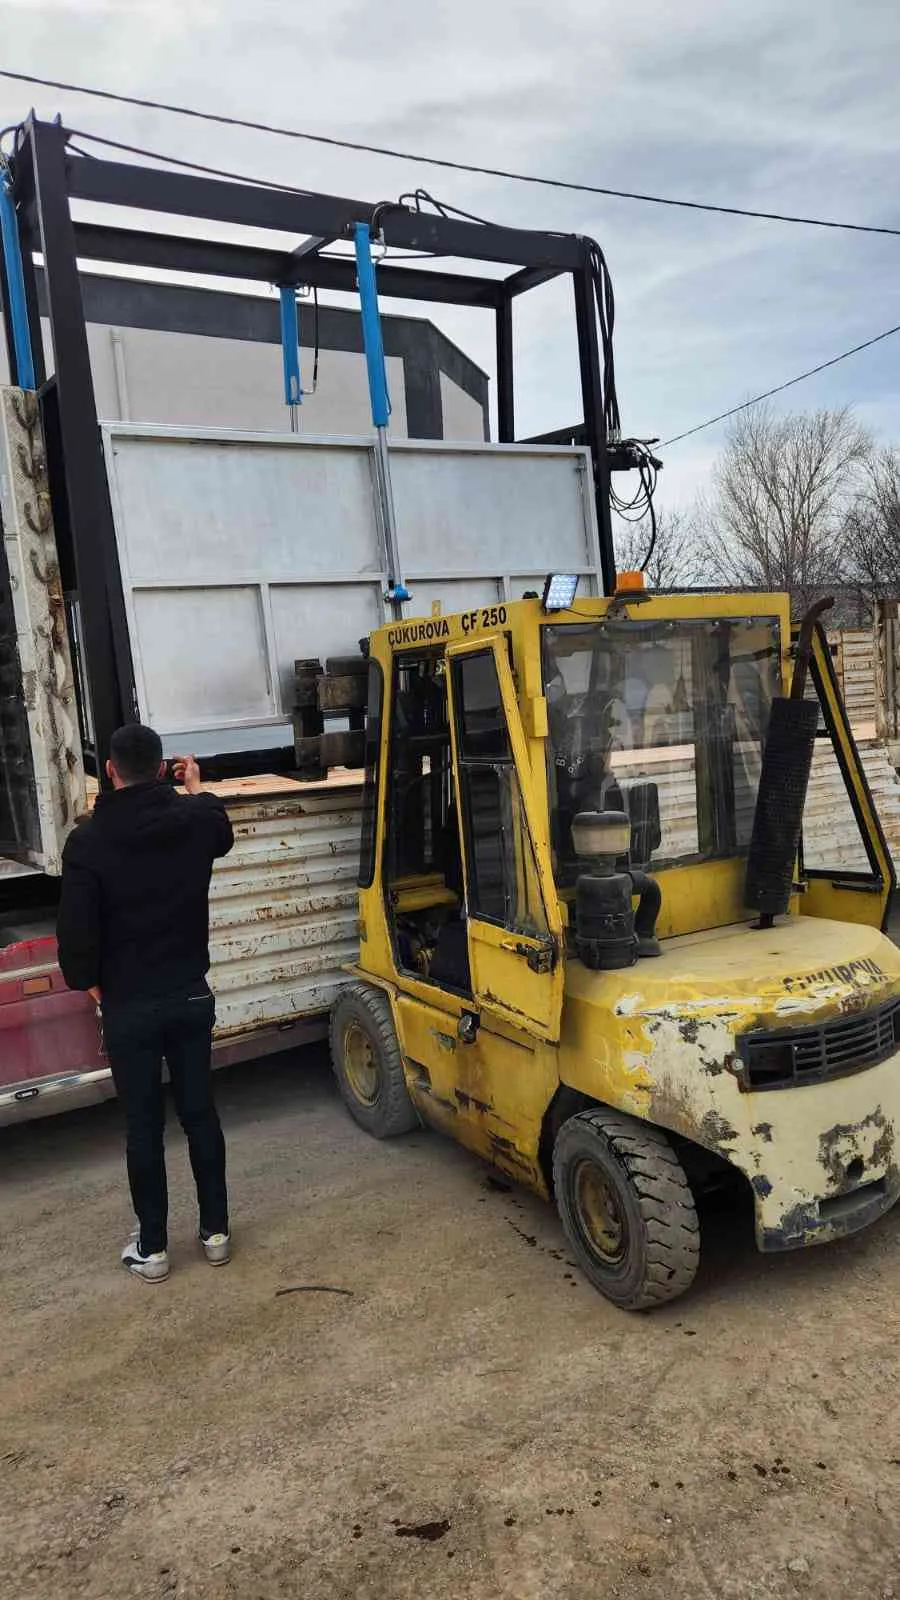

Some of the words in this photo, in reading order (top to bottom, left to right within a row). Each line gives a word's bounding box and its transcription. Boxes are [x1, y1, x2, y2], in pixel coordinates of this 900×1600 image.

[388, 620, 450, 648] ÇUKUROVA
[461, 611, 479, 636] ÇF
[482, 606, 507, 628] 250
